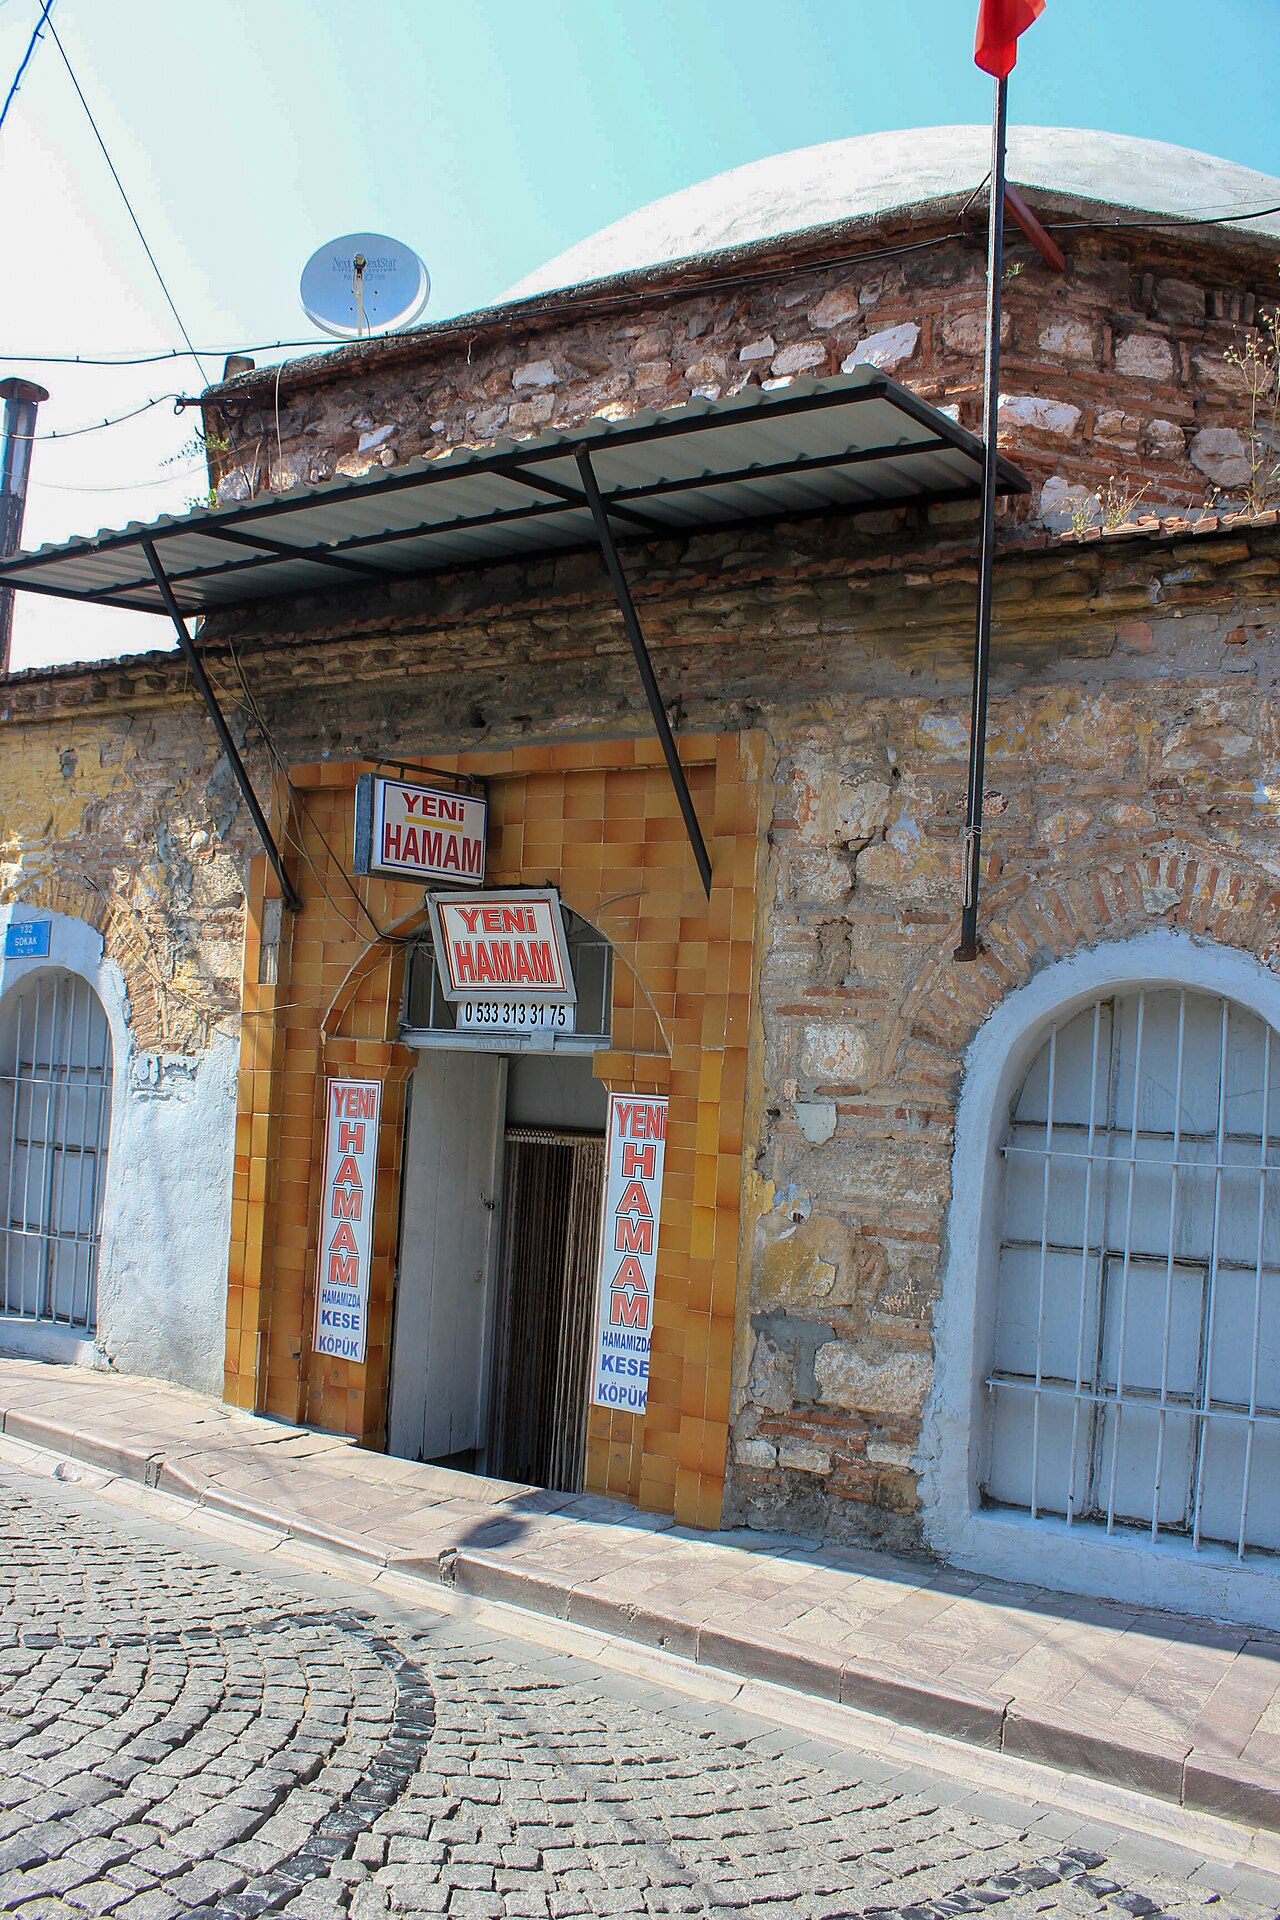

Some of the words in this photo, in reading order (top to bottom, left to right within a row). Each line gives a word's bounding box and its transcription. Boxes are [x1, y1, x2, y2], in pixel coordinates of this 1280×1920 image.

[384, 822, 482, 874] HAMAM
[15, 936, 37, 946] SOKAK
[453, 940, 557, 983] HAMAM
[465, 1002, 473, 1022] 0
[476, 1002, 499, 1023] 533
[502, 1003, 526, 1024] 313
[530, 1003, 544, 1025] 31
[550, 1005, 566, 1026] 75
[328, 1121, 366, 1288] HAMAM
[609, 1142, 657, 1330] HAMAM
[321, 1289, 361, 1309] HAMAMIZDA
[321, 1309, 360, 1331] KESE
[318, 1334, 359, 1357] KÖPÜK
[601, 1354, 650, 1378] KESE
[598, 1381, 648, 1407] KÖPÜK
